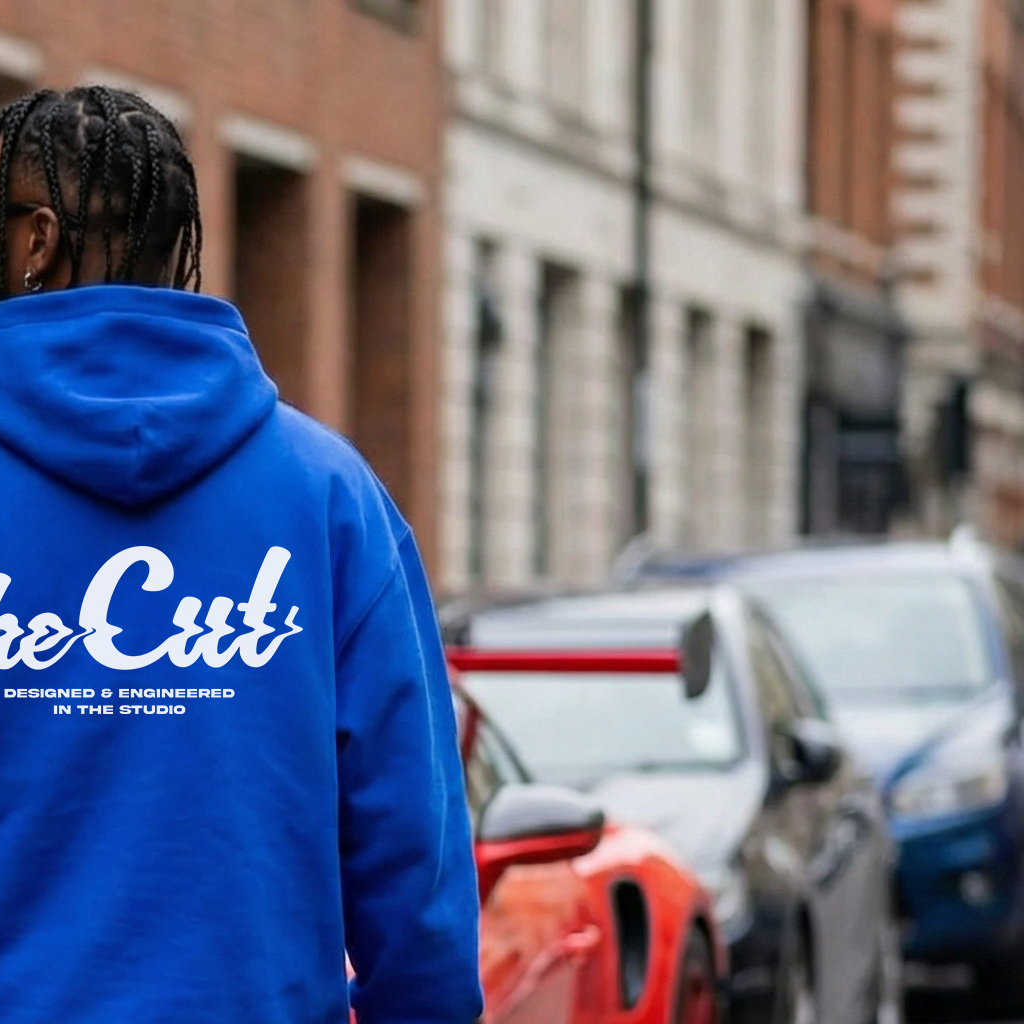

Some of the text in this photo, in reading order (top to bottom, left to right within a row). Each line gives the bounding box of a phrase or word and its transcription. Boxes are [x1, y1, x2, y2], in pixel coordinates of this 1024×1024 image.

[3, 687, 236, 699] DESIGNED & ENGINEERED
[53, 704, 186, 715] IN THE STUDIO
